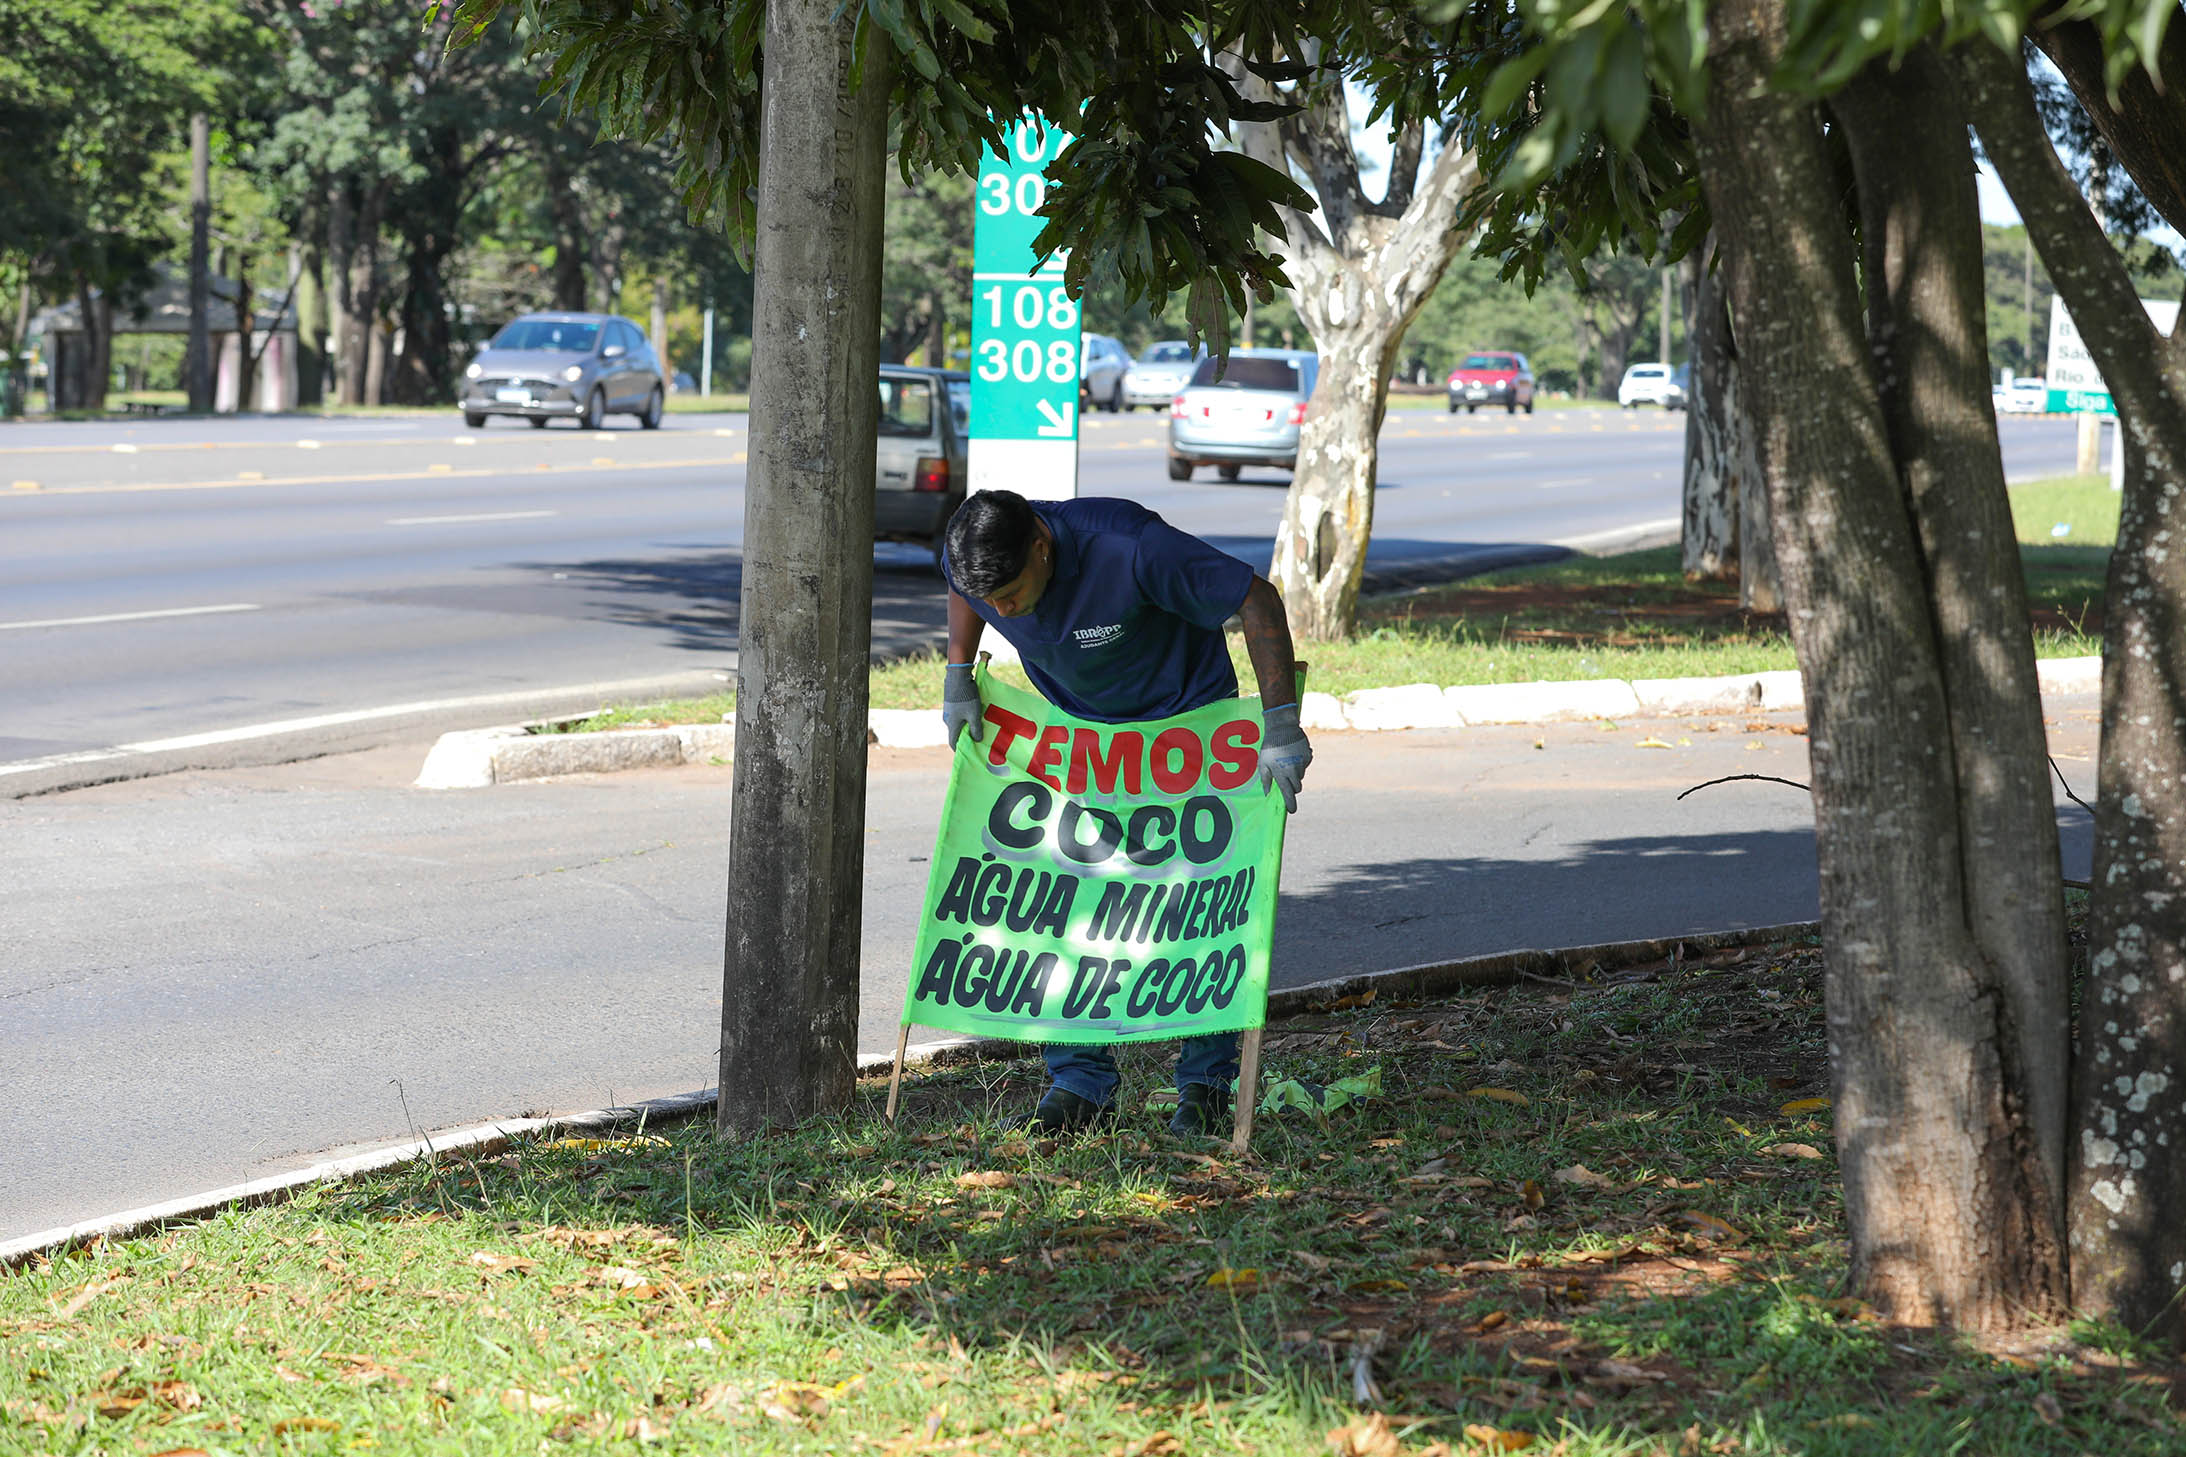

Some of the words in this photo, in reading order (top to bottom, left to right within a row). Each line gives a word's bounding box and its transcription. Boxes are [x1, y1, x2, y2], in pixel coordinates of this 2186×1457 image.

[981, 172, 1062, 216] 30
[982, 285, 1077, 329] 108
[977, 339, 1076, 383] 308
[984, 703, 1261, 796] TEMOS
[988, 781, 1234, 866] COCO
[935, 852, 1080, 938] ÁGUA
[1086, 865, 1256, 945] MINERAL
[914, 932, 1059, 1017] ÁGUA
[1061, 955, 1132, 1020] DE
[1126, 943, 1247, 1019] COCO
